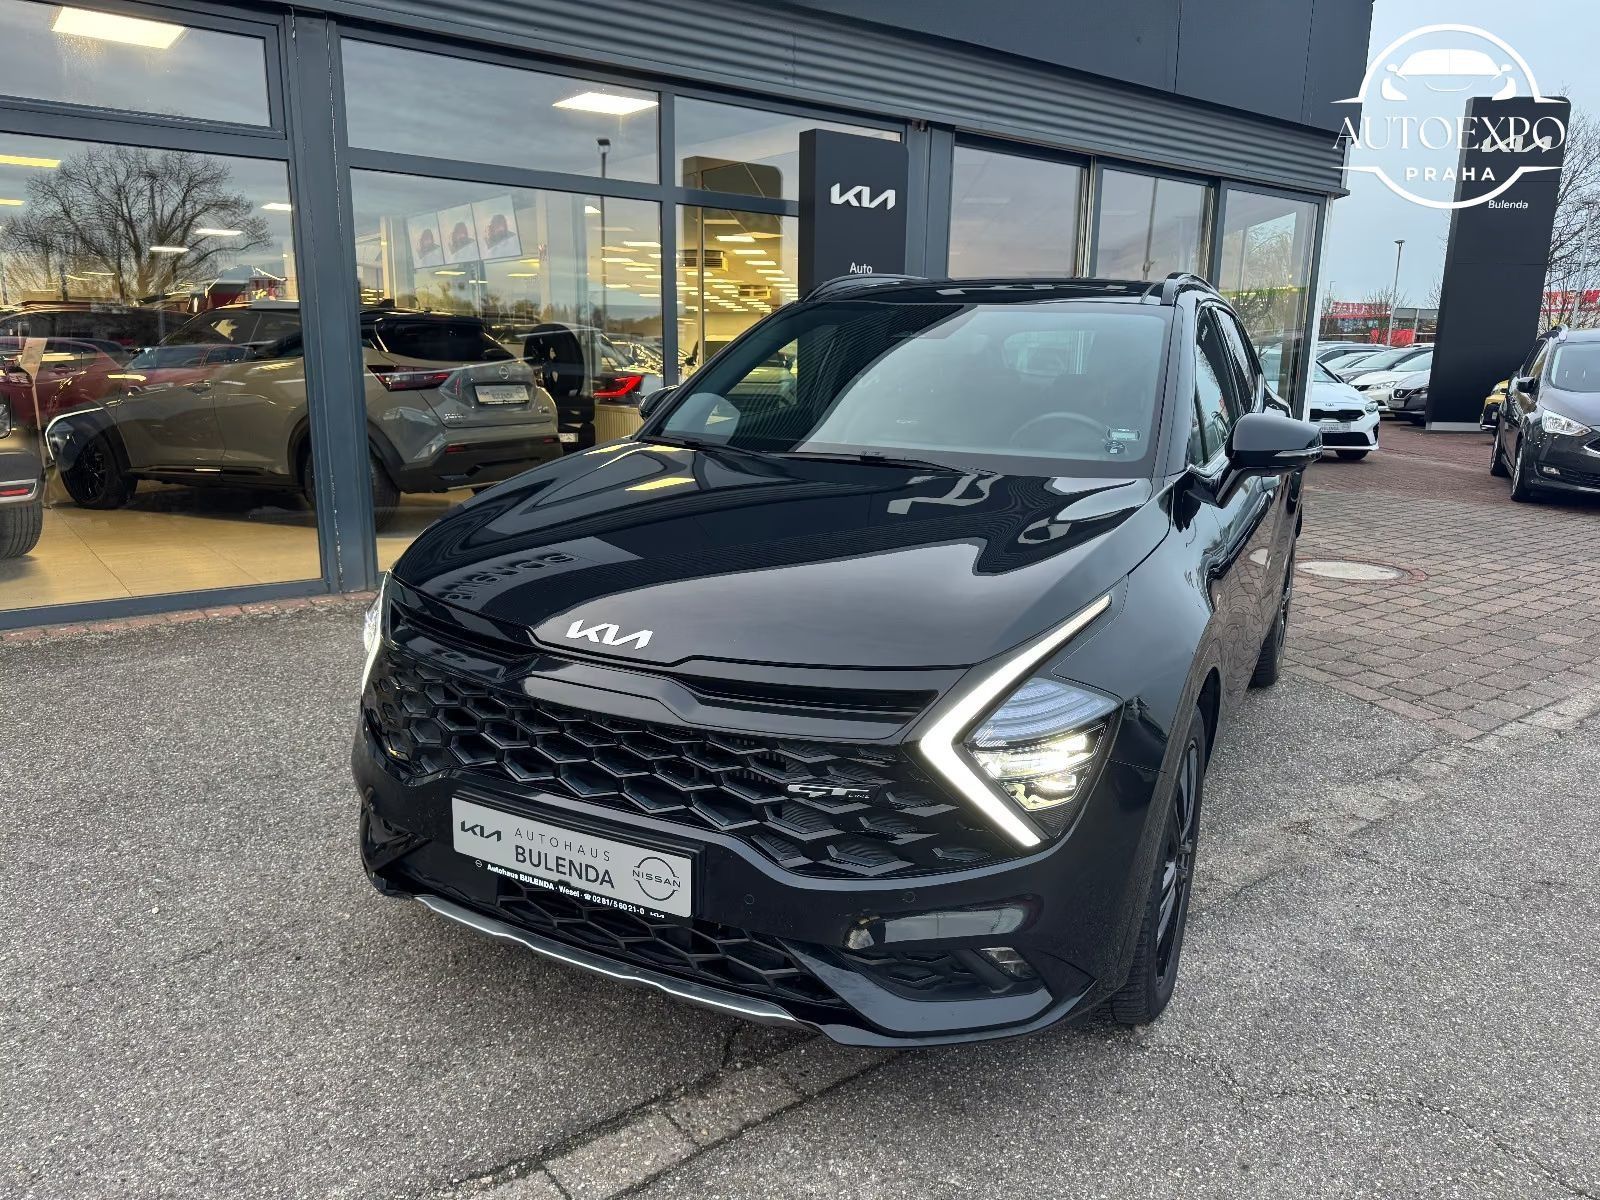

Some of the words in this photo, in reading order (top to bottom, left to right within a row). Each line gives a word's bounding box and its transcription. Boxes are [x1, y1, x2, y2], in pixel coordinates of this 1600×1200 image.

[830, 182, 896, 210] KIA
[1488, 200, 1529, 210] Bulenda
[849, 262, 873, 274] Auto
[565, 619, 653, 650] KIA
[461, 820, 502, 842] KIA
[515, 827, 610, 861] AUTOHAUS
[487, 863, 519, 880] Autohaus
[519, 873, 555, 891] BULENDA
[557, 884, 580, 898] Wesel
[515, 845, 615, 889] BULENDA
[632, 869, 681, 888] NISSAN
